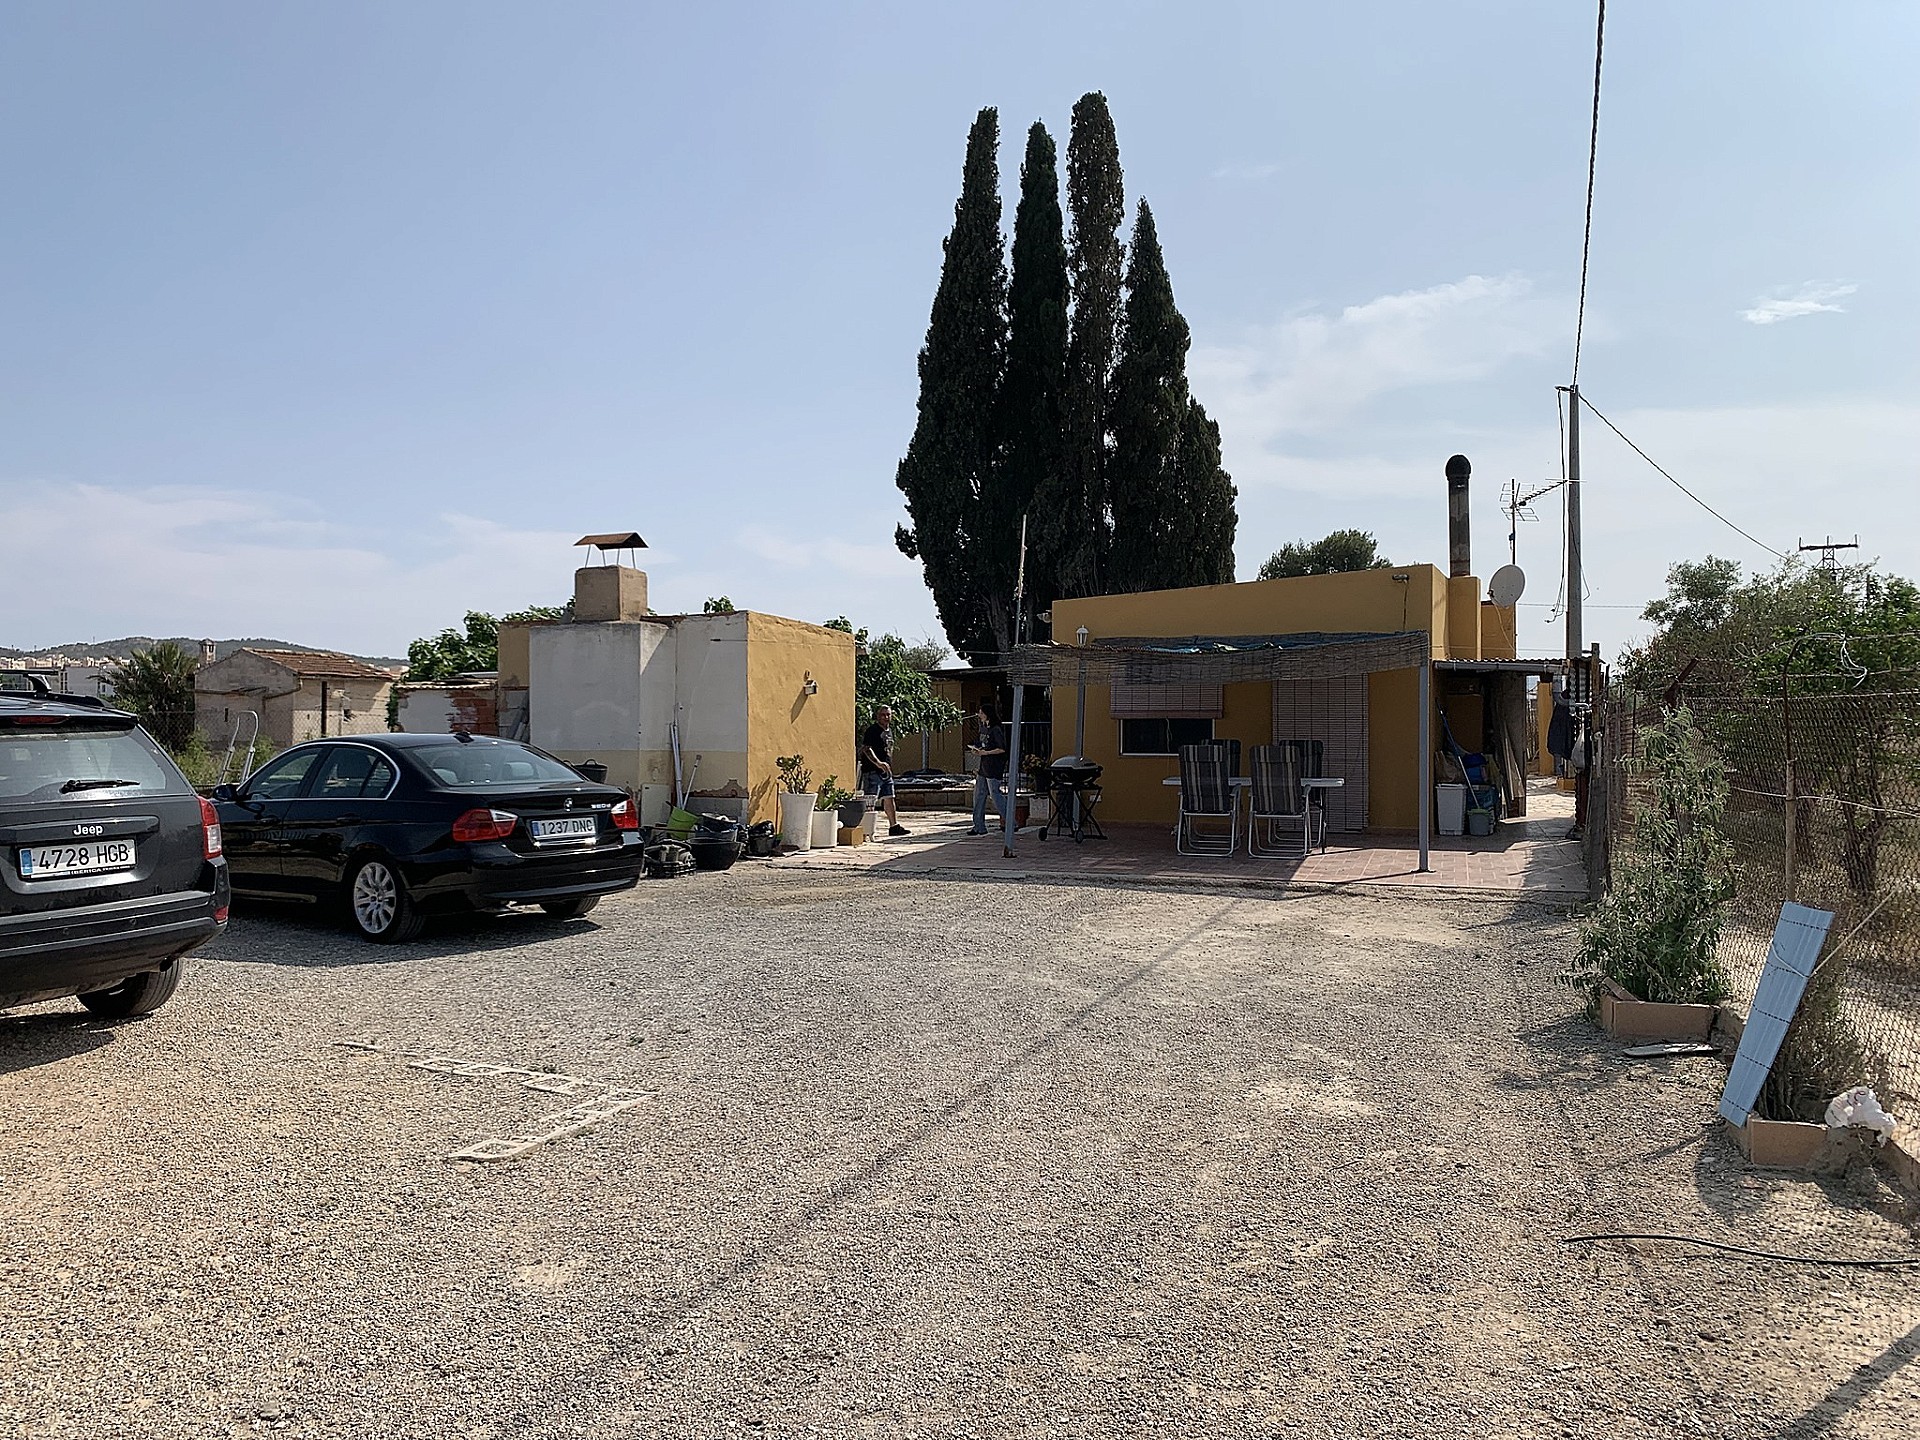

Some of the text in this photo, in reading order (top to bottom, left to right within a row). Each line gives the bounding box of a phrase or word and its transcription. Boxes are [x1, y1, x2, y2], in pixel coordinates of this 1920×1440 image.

[73, 824, 103, 836] Jeep
[542, 820, 592, 835] 1237 DNC
[39, 844, 128, 869] 4728 HGB
